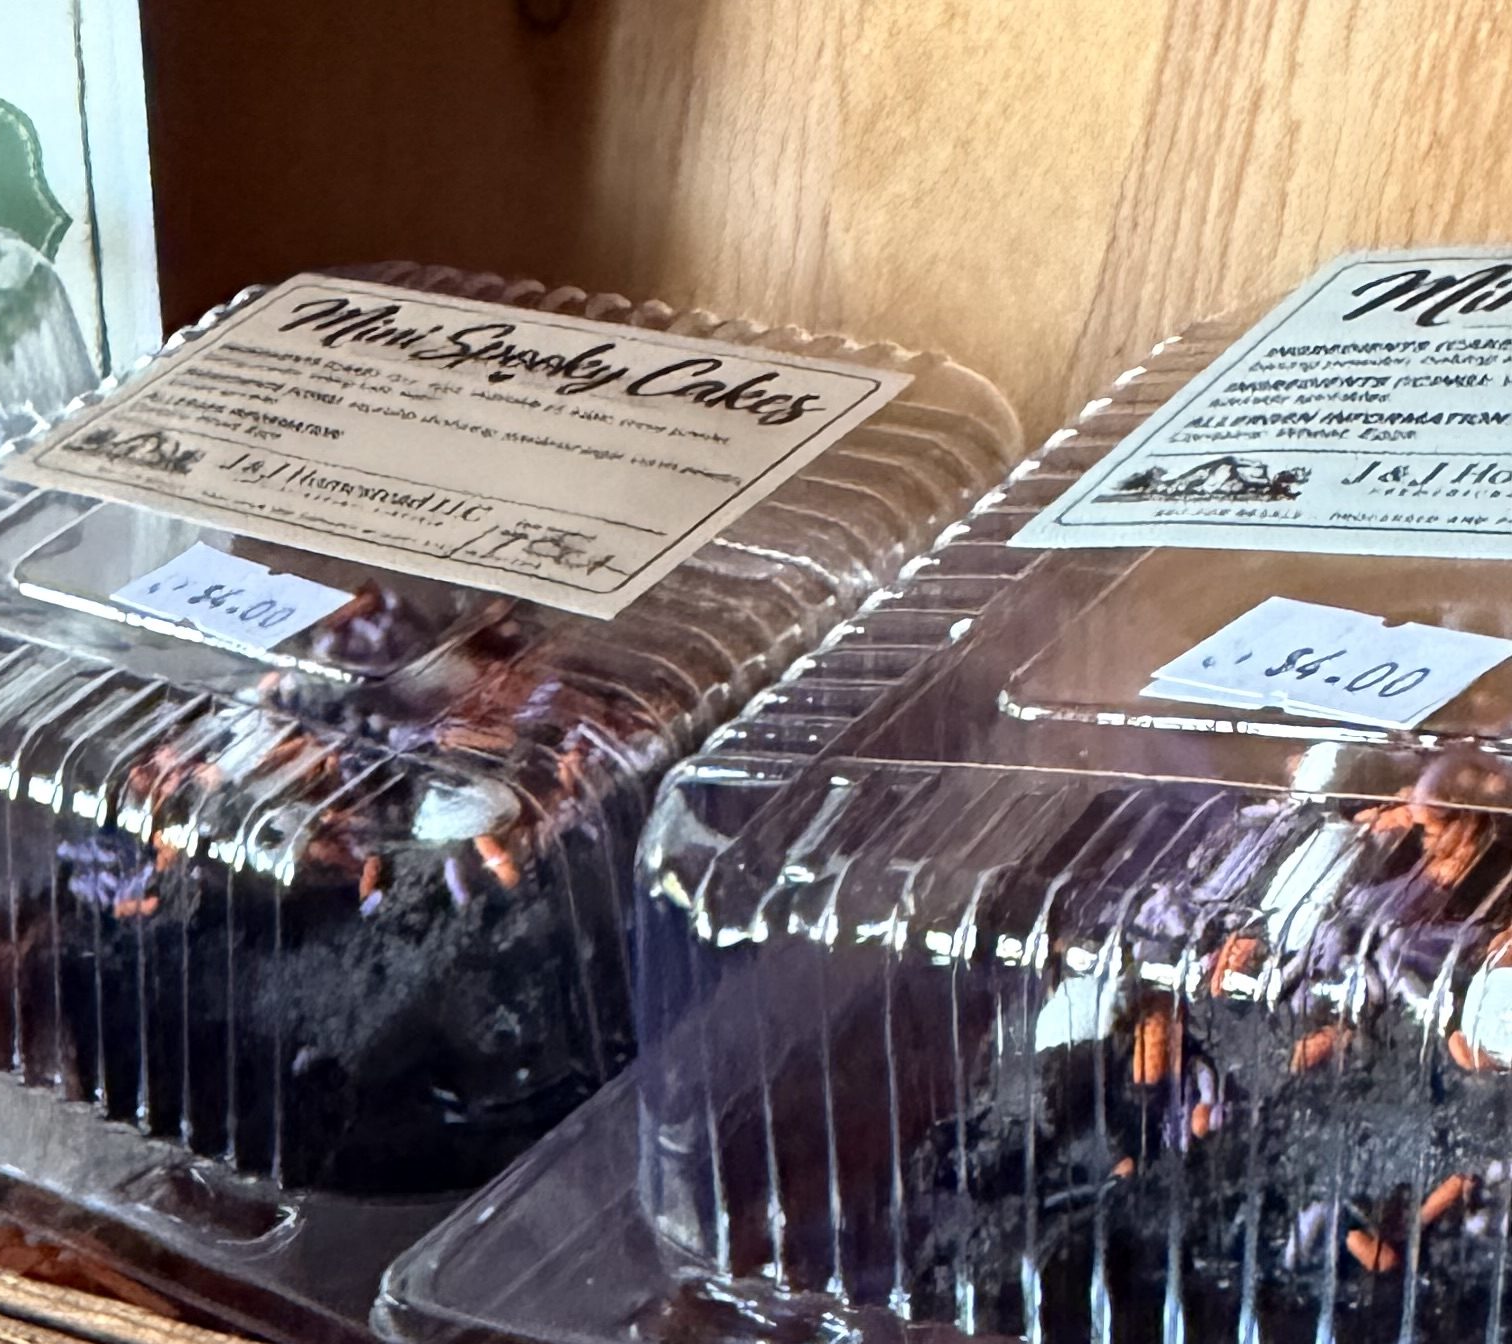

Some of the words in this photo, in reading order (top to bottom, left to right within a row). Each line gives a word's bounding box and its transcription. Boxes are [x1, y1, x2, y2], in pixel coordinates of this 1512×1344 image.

[1342, 264, 1512, 327] Mi
[279, 298, 443, 348] Mini
[414, 323, 628, 395] Spooky
[627, 358, 826, 426] Cakes
[187, 584, 295, 629] $4.00
[1264, 647, 1431, 698] $4.00
